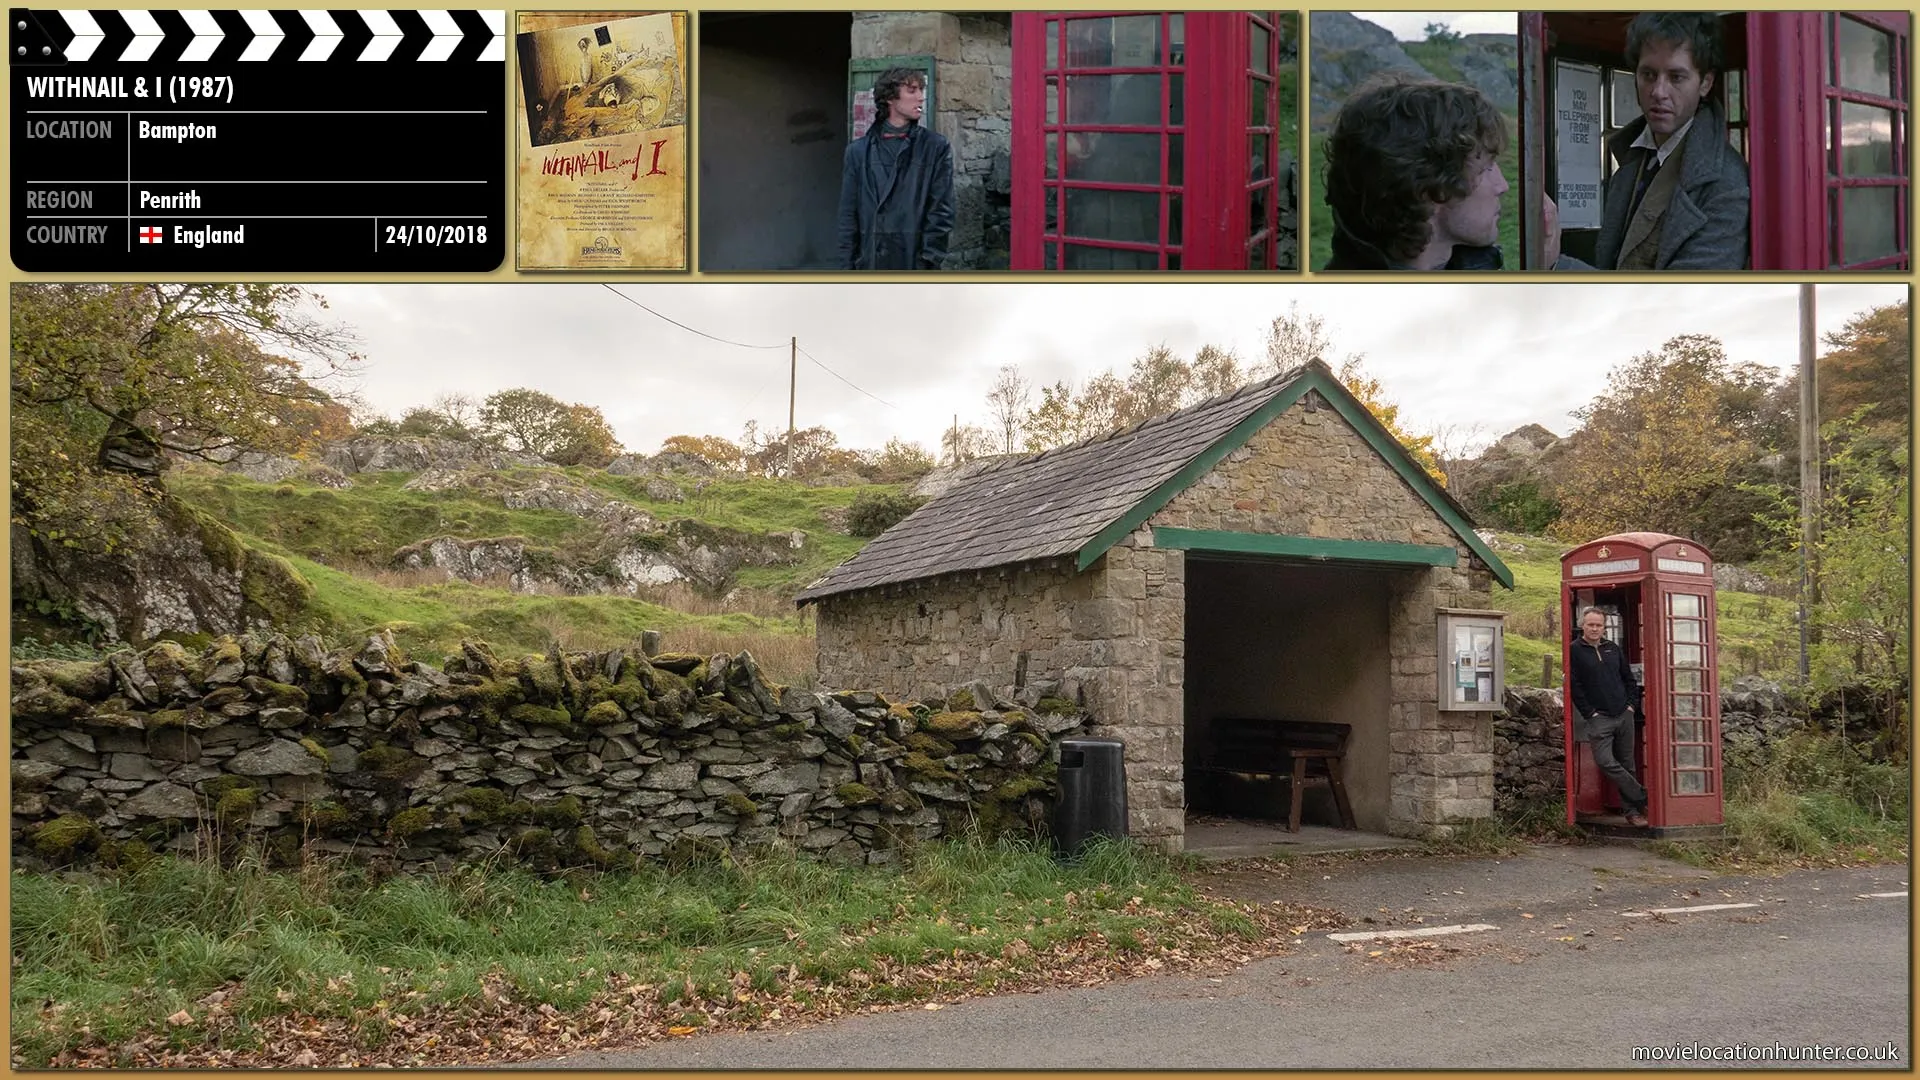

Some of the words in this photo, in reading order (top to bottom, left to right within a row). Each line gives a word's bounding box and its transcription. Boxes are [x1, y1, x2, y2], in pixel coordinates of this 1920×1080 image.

[1572, 88, 1587, 101] YOU
[1572, 100, 1587, 111] MAY
[1559, 110, 1600, 124] TELEPHONE
[1569, 122, 1590, 133] FROM
